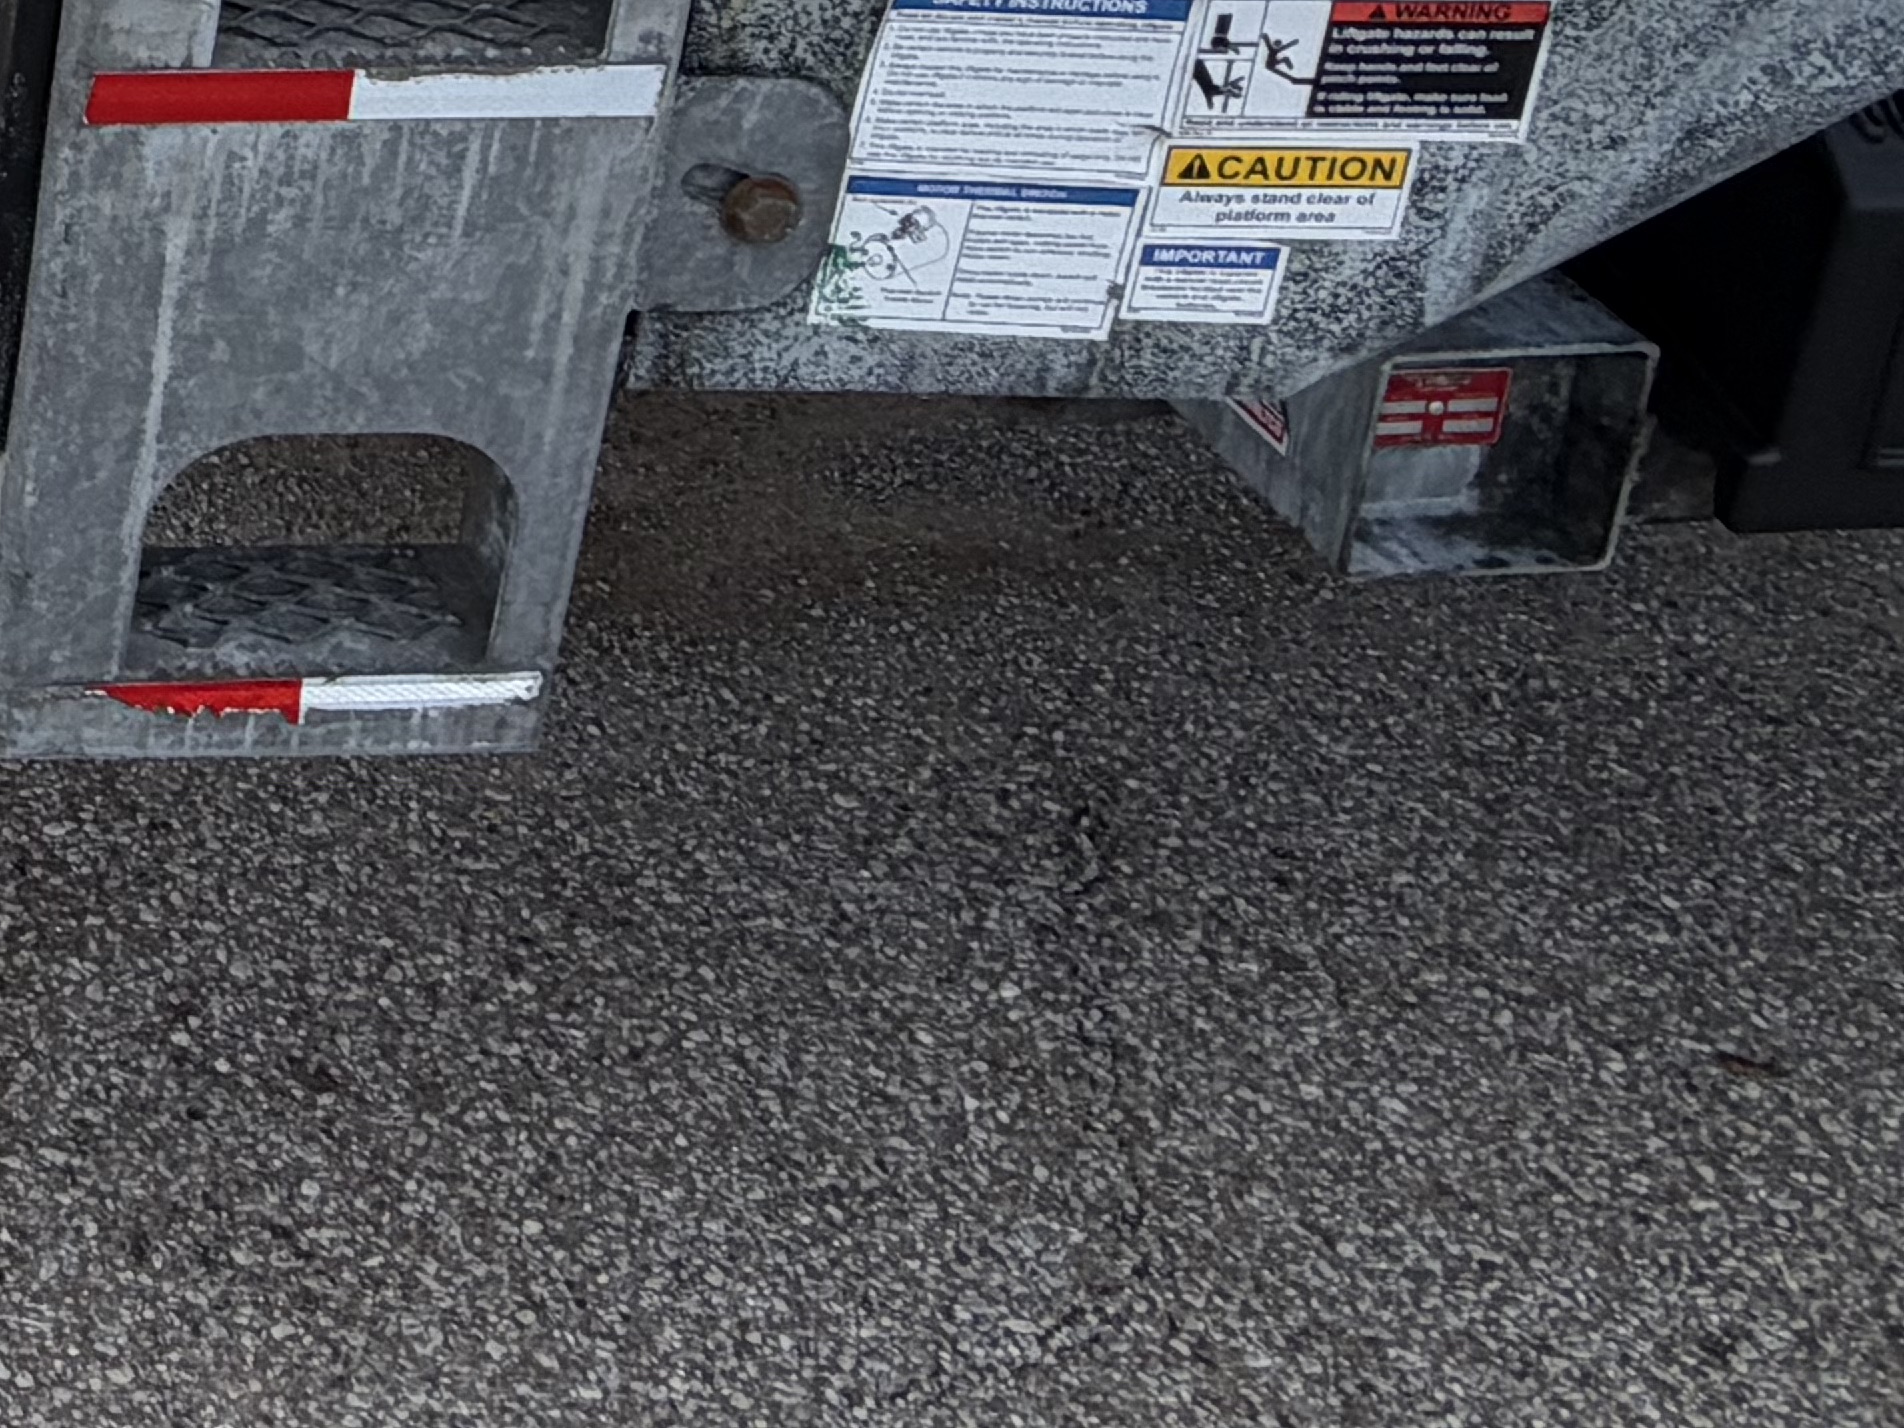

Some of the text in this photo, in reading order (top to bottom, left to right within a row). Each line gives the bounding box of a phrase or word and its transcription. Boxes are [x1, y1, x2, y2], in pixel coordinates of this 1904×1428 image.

[1394, 3, 1512, 20] WARNING
[1217, 155, 1398, 183] CAUTION
[1178, 190, 1376, 207] Always stand clear of
[1214, 208, 1336, 224] platform area
[1152, 248, 1266, 264] IMPORTANT
